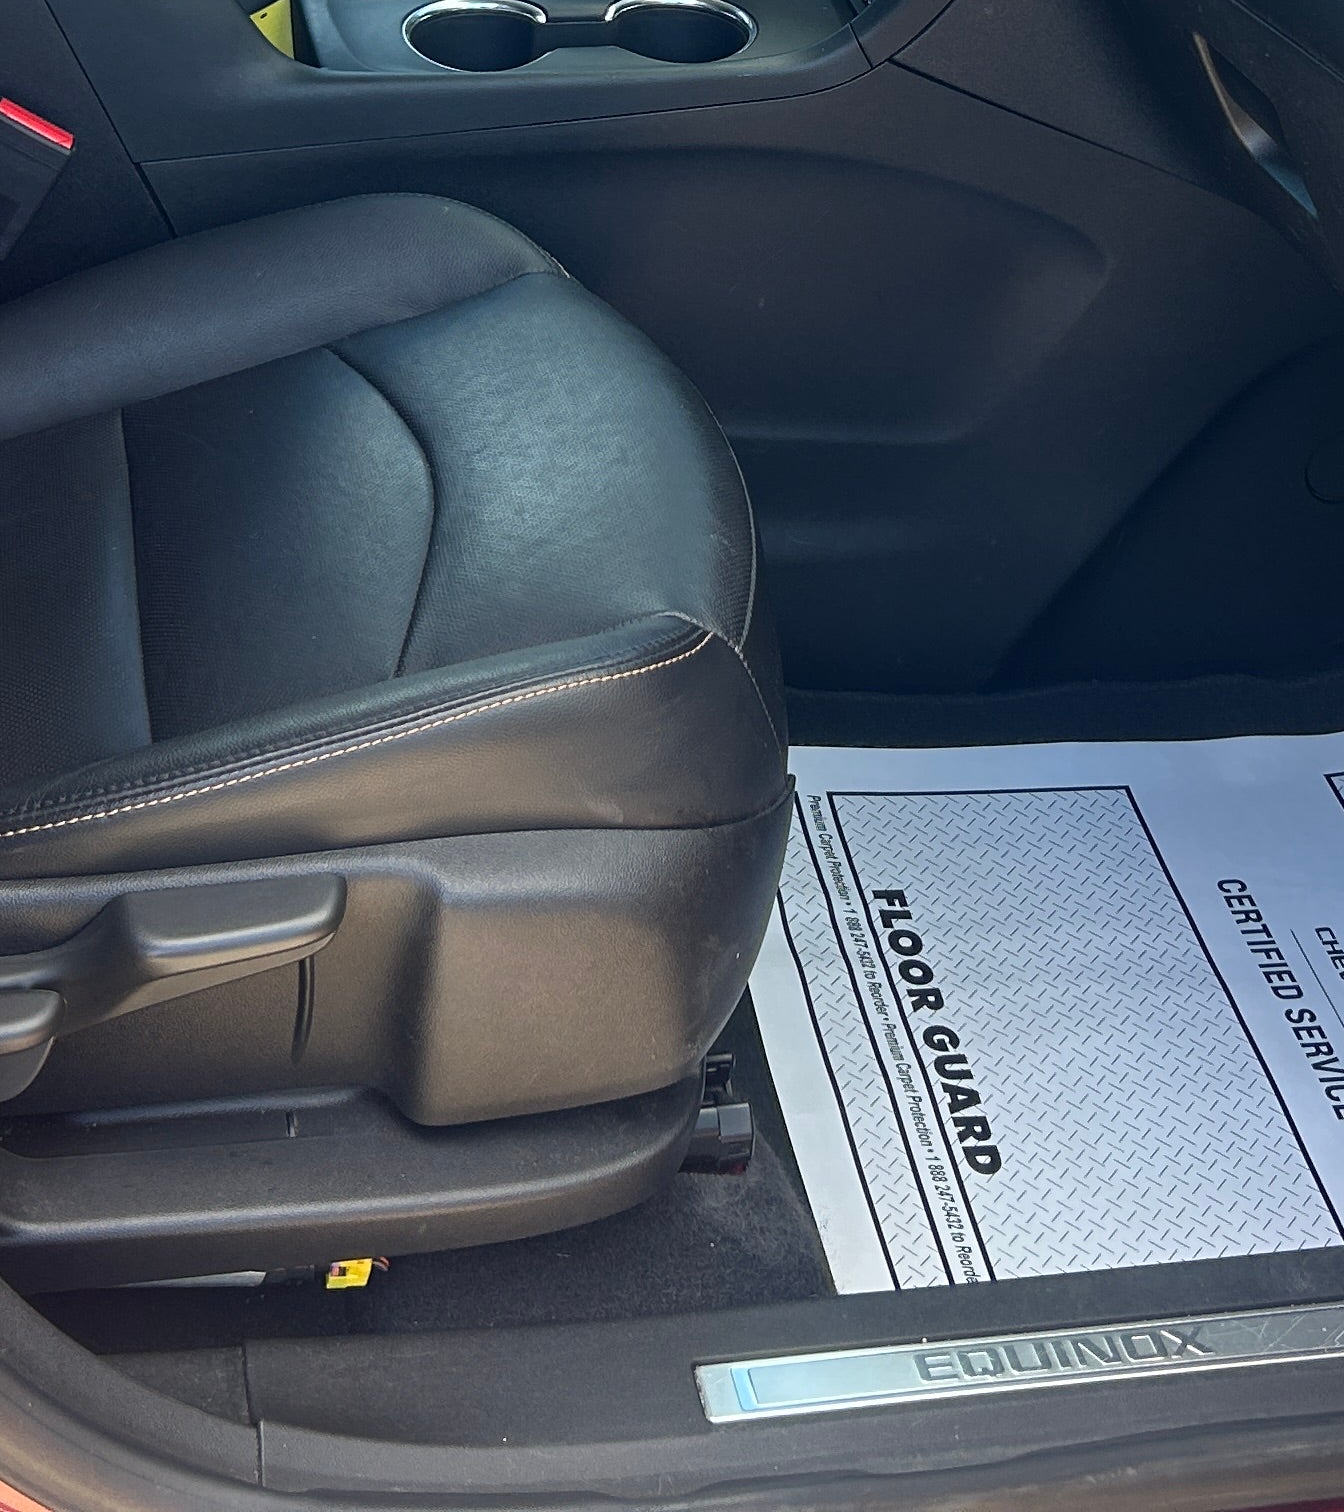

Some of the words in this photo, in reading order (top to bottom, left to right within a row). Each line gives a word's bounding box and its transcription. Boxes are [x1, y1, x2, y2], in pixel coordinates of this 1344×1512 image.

[1217, 878, 1304, 1000] CERTIFIED
[871, 889, 944, 1012] FLOOR
[922, 1024, 1002, 1175] GUARD
[881, 1023, 904, 1061] Premium
[896, 1063, 919, 1093] Carpet
[906, 1095, 933, 1147] Protection
[928, 1164, 948, 1182] 888
[934, 1185, 964, 1230] 247-5432
[950, 1232, 967, 1243] to
[955, 1245, 981, 1284] Reorde
[913, 1327, 1216, 1384] EQUINOX
